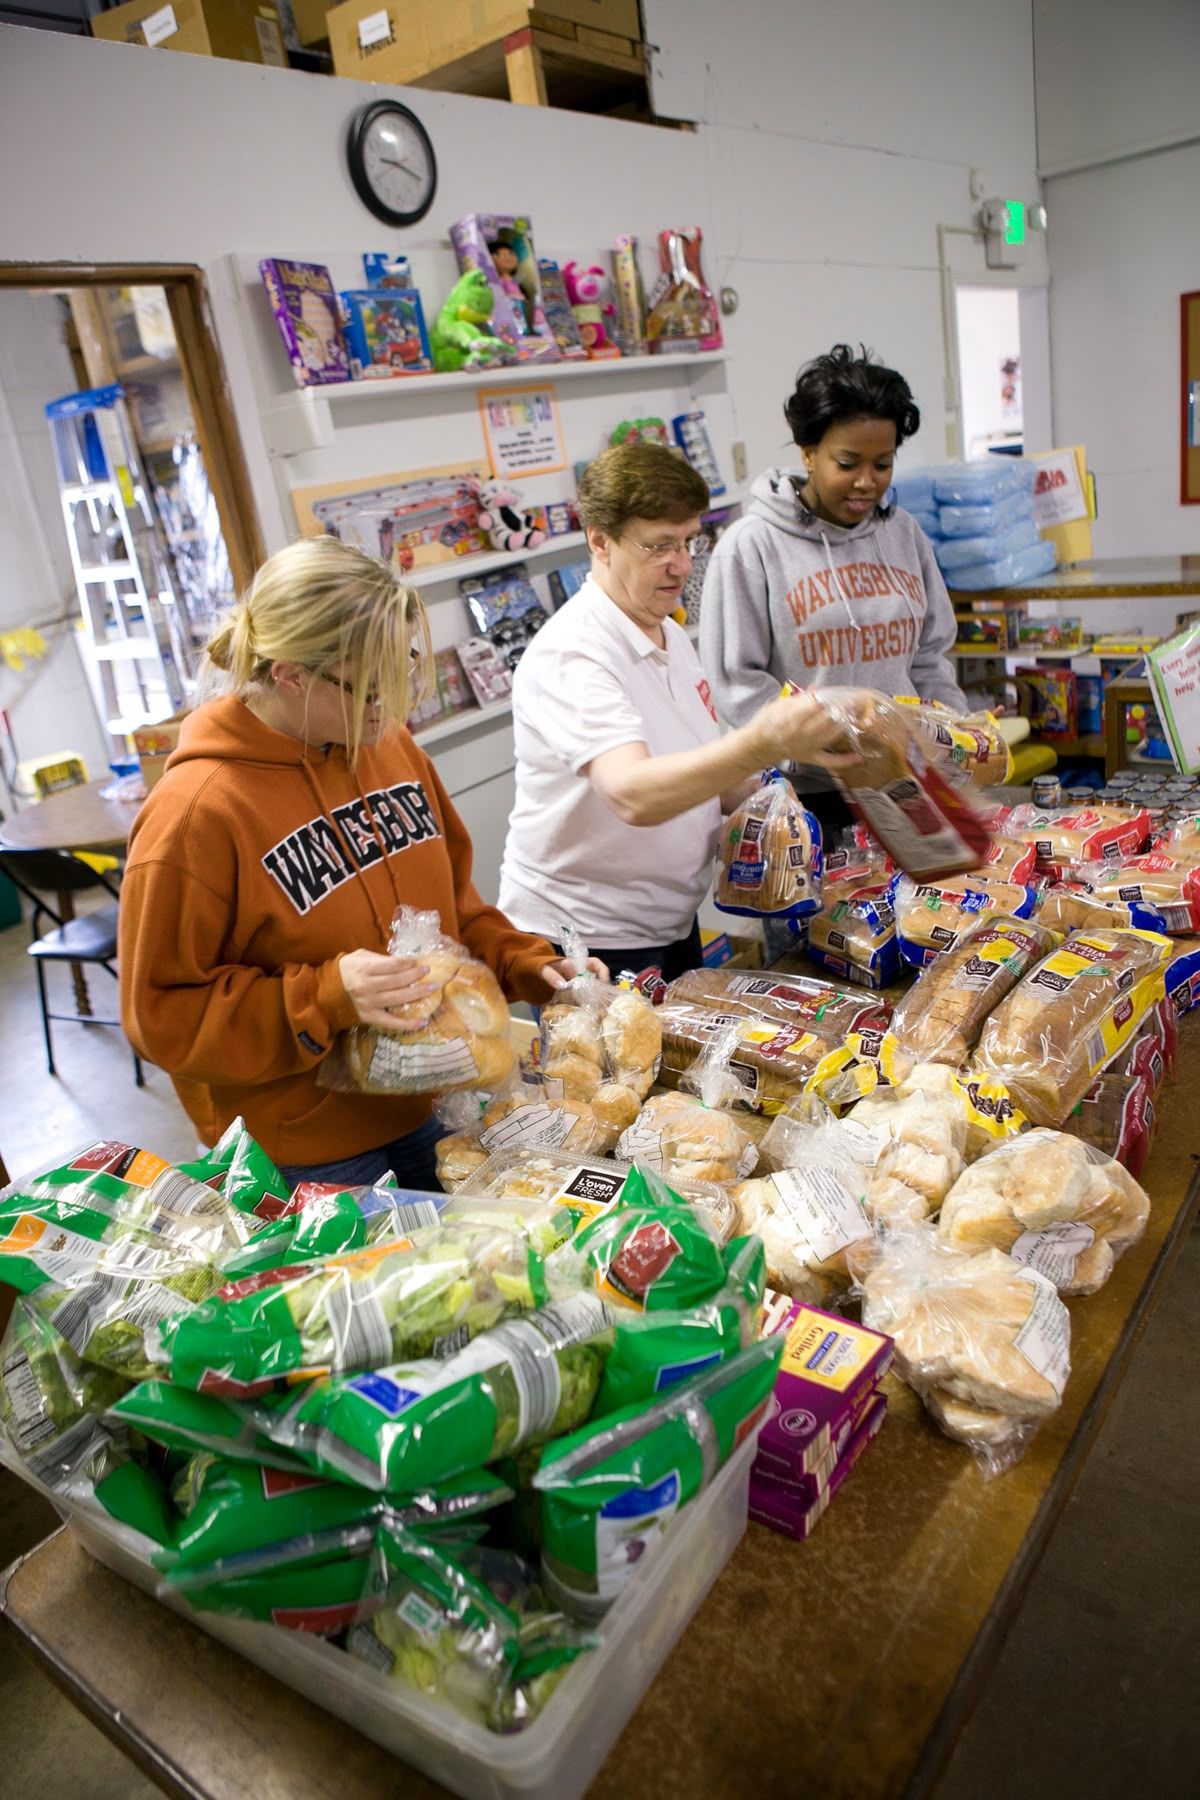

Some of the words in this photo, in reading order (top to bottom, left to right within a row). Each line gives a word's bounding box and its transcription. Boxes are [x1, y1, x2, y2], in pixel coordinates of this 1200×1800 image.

[261, 781, 442, 916] WAYESBUR
[573, 1184, 611, 1199] FRESH
[578, 1177, 614, 1192] L'oven
[791, 1326, 824, 1360] Grilled
